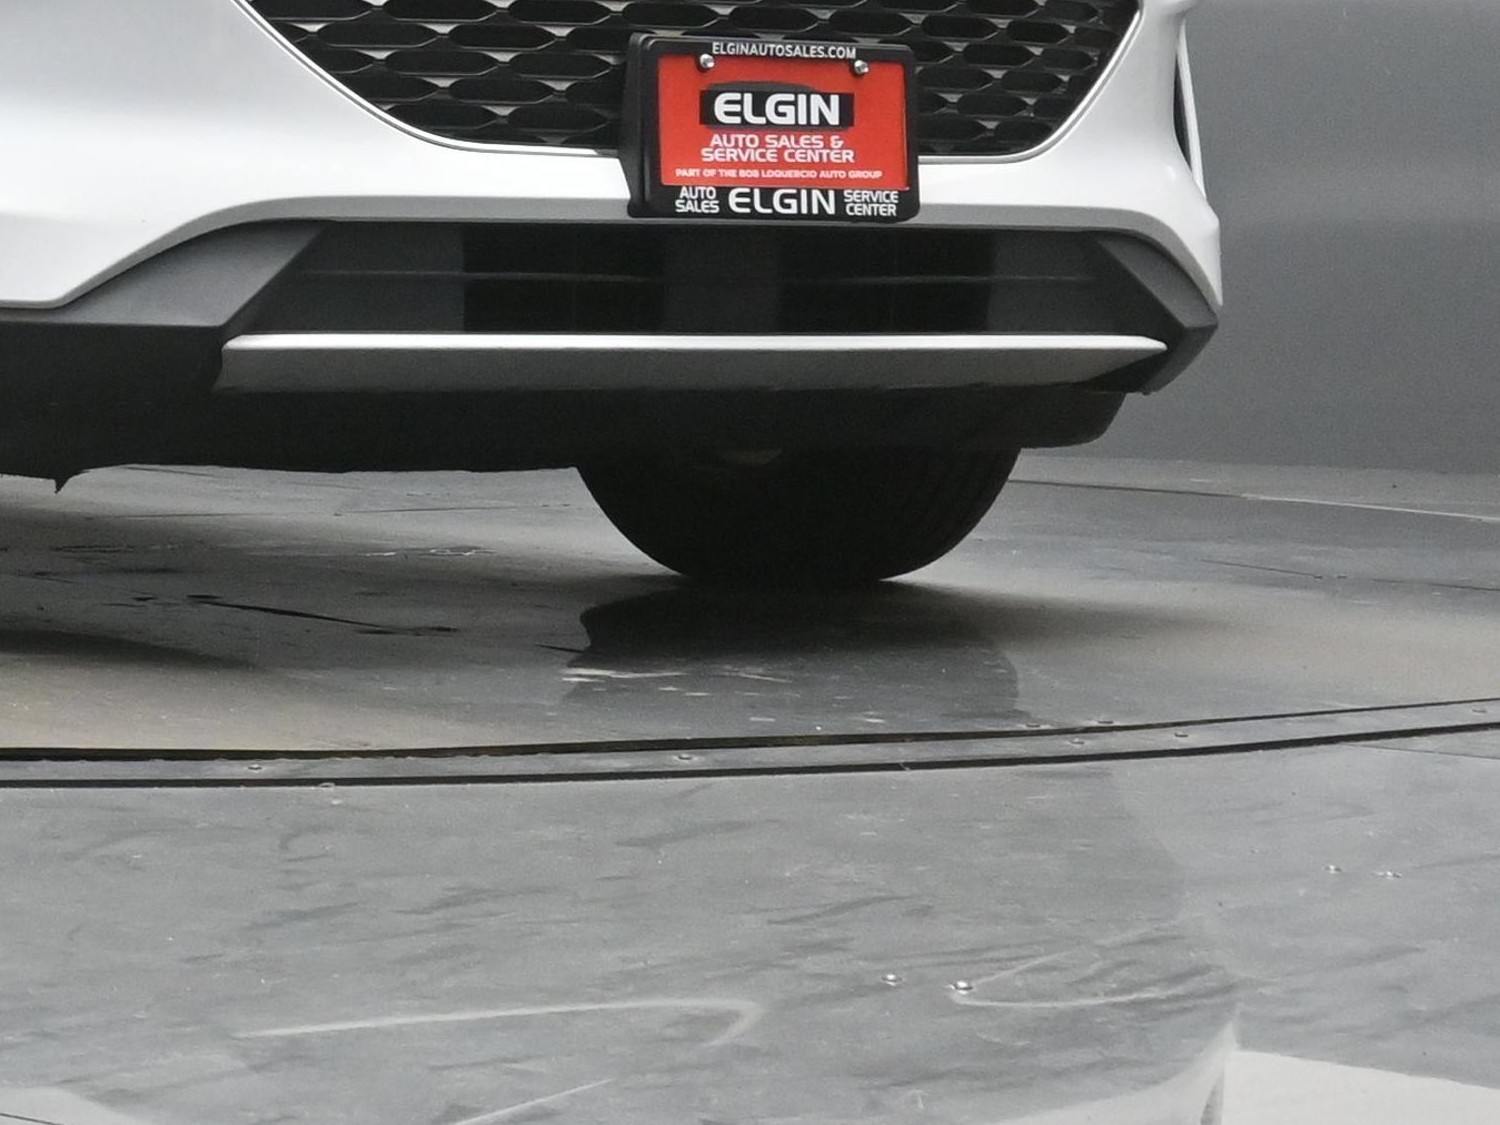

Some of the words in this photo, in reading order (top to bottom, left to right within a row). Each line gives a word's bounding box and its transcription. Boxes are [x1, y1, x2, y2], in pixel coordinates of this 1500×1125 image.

[712, 42, 856, 59] ELGINAUTOSALES.COM
[714, 92, 840, 125] ELGIN
[709, 134, 760, 148] AUTO
[765, 135, 825, 149] SALES
[830, 135, 844, 149] &
[701, 148, 779, 163] SERVICE
[784, 149, 855, 163] CENTER
[675, 168, 700, 178] PART
[703, 168, 717, 178] OF
[719, 169, 738, 178] THE
[819, 170, 847, 179] AUTO
[848, 170, 883, 179] GROUP
[679, 186, 716, 200] AUTO
[843, 189, 899, 204] SERVICE
[675, 199, 720, 213] SALES
[728, 187, 836, 215] ELGIN
[845, 203, 897, 217] CENTER
